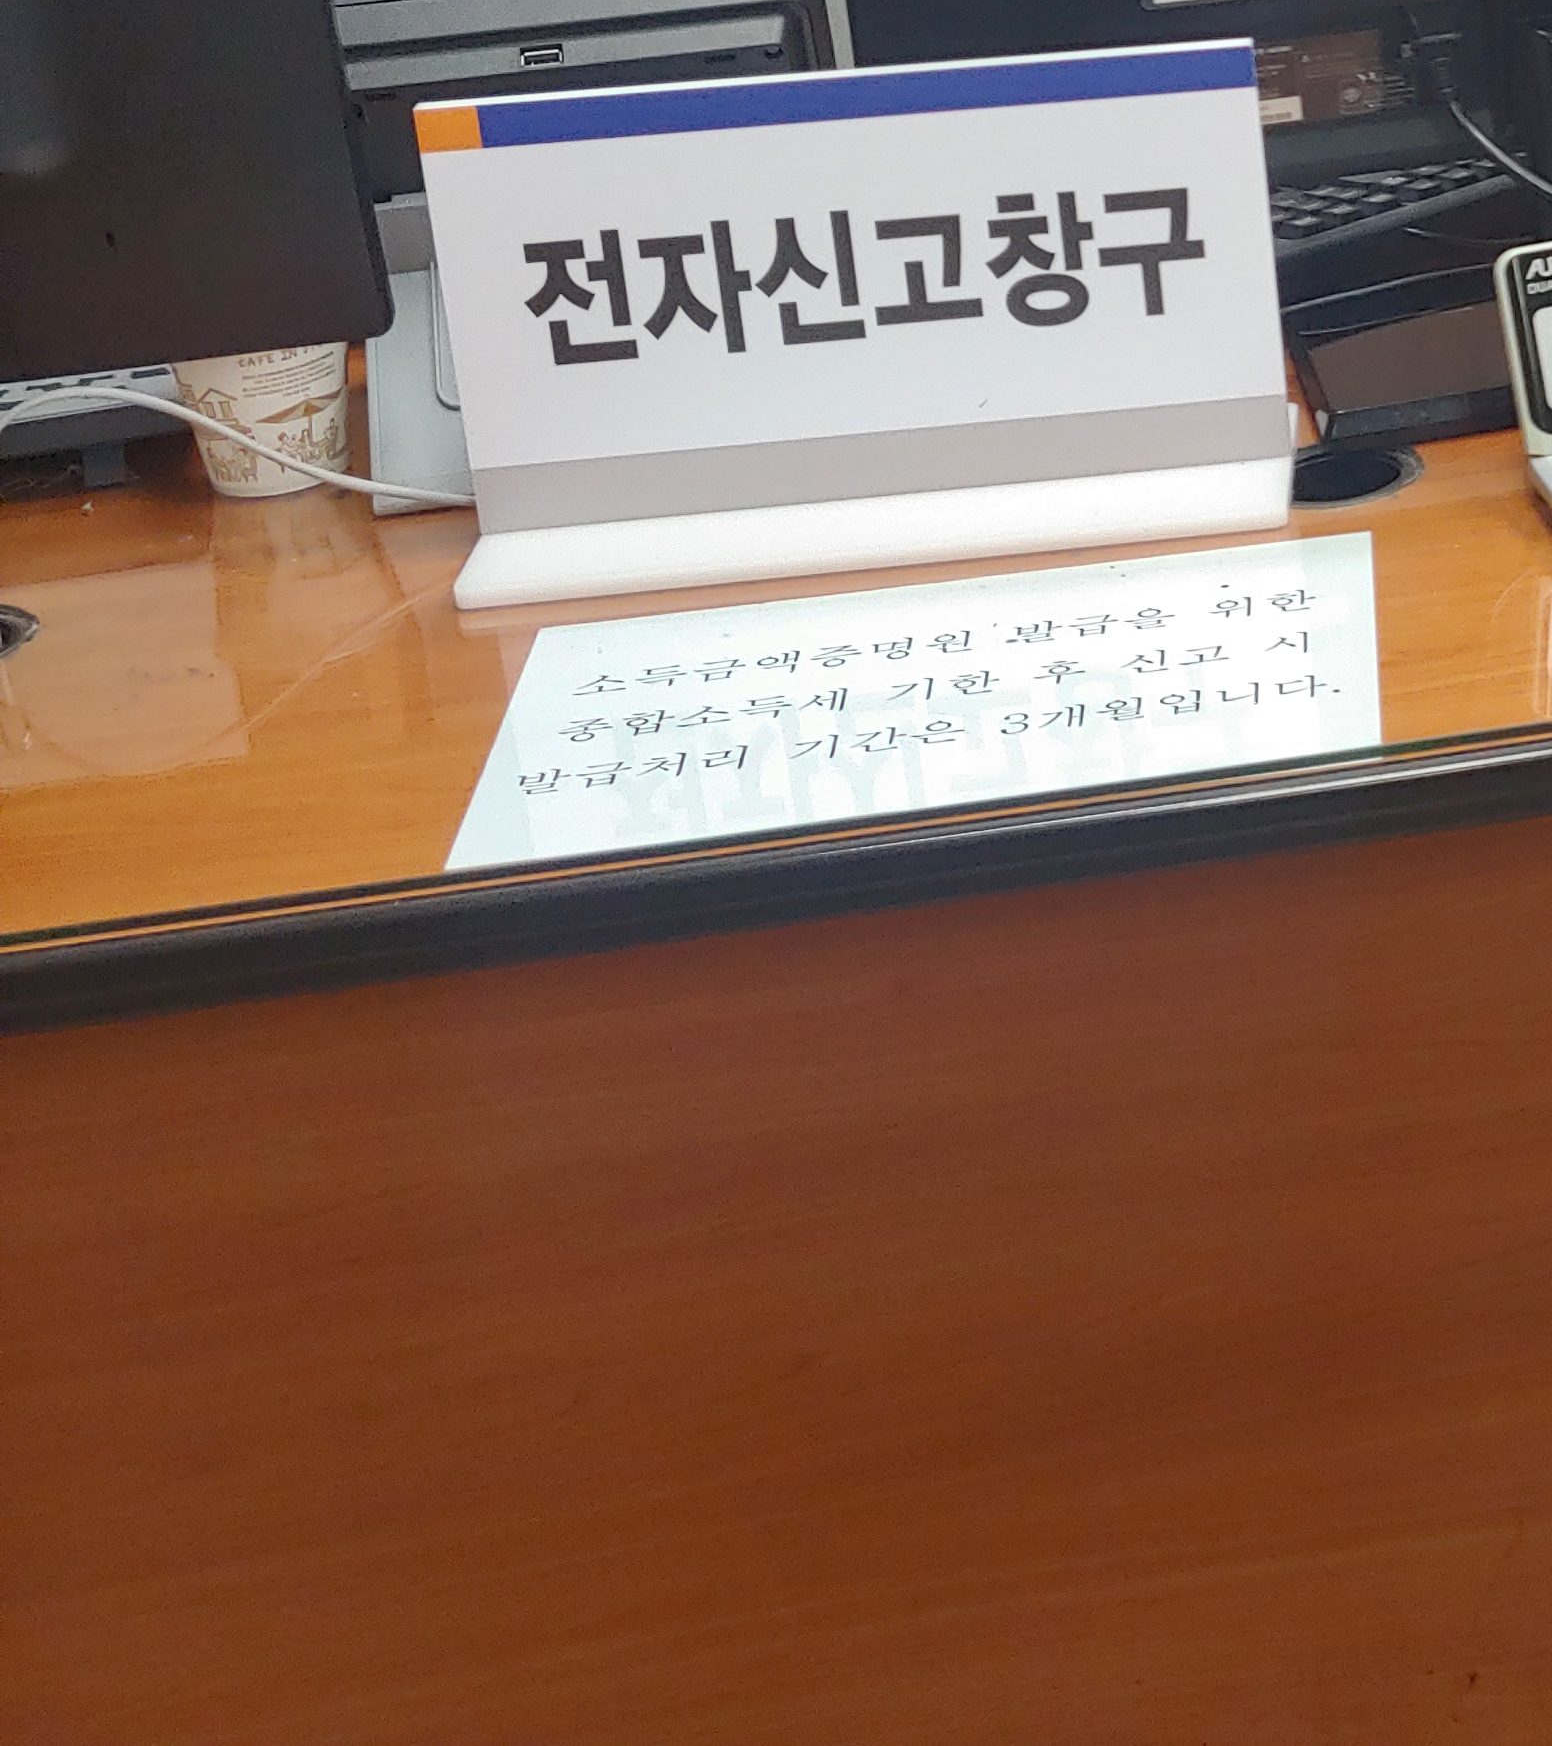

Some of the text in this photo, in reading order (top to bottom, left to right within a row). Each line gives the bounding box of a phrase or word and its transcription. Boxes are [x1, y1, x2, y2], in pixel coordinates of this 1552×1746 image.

[523, 185, 1206, 367] 전자신고창구
[557, 631, 1310, 743] 종합소득세 기한 후 신고 시
[572, 589, 1318, 697] 소득금액증명원 발급을 위한
[516, 674, 1342, 796] 발급처리 기간은 3개월입니다.
